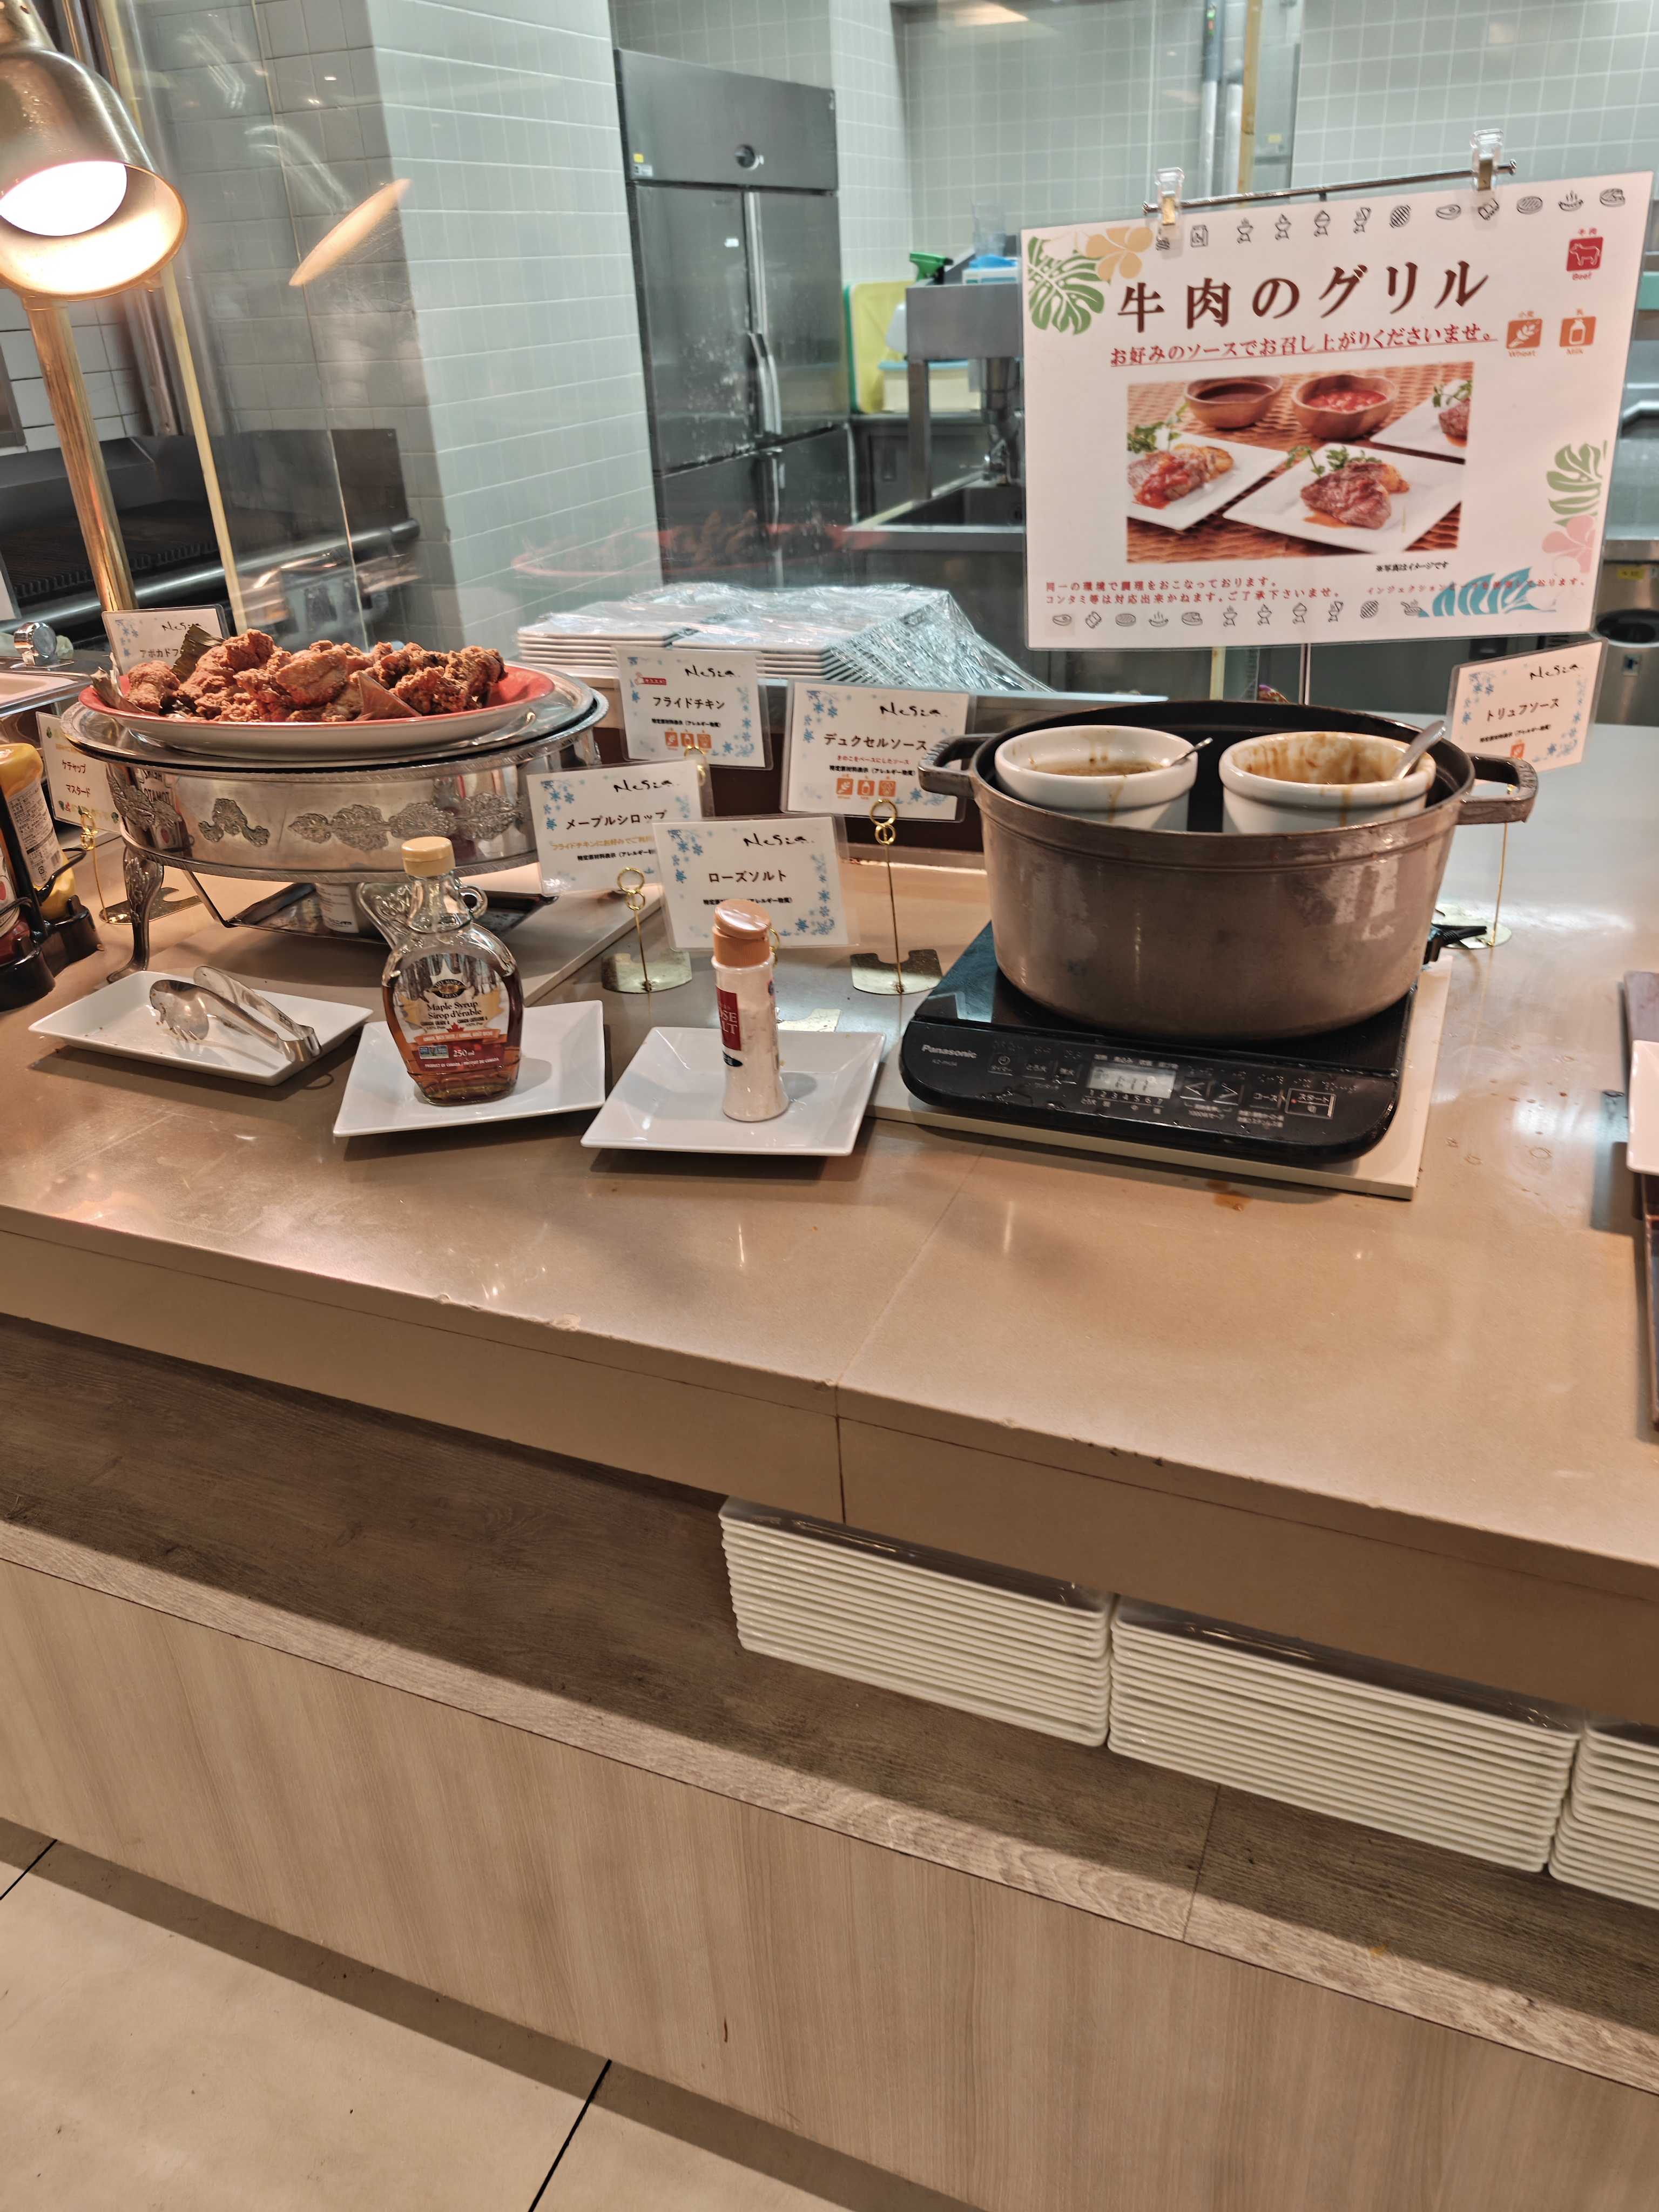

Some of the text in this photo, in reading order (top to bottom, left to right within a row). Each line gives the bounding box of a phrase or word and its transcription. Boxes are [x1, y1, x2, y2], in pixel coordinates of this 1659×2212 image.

[1117, 260, 1489, 333] 牛肉のグリル
[1110, 323, 1492, 366] お好みのソースでお召し上がりくださいませ。
[1046, 576, 1277, 592] 同一の環境で調理をおこなっております。
[139, 649, 184, 658] アボカドフ
[652, 696, 726, 710] フライドチキン
[1486, 698, 1560, 722] トリュフソース
[824, 733, 928, 751] デュクセルソース
[65, 783, 91, 798] マスタード
[566, 809, 668, 830] メープルシロップ
[709, 869, 787, 884] ローズソルト
[427, 1001, 478, 1012] Maple Syrup
[428, 1010, 450, 1021] Sirop
[453, 1049, 467, 1057] 250
[921, 1043, 977, 1059] Panasonic
